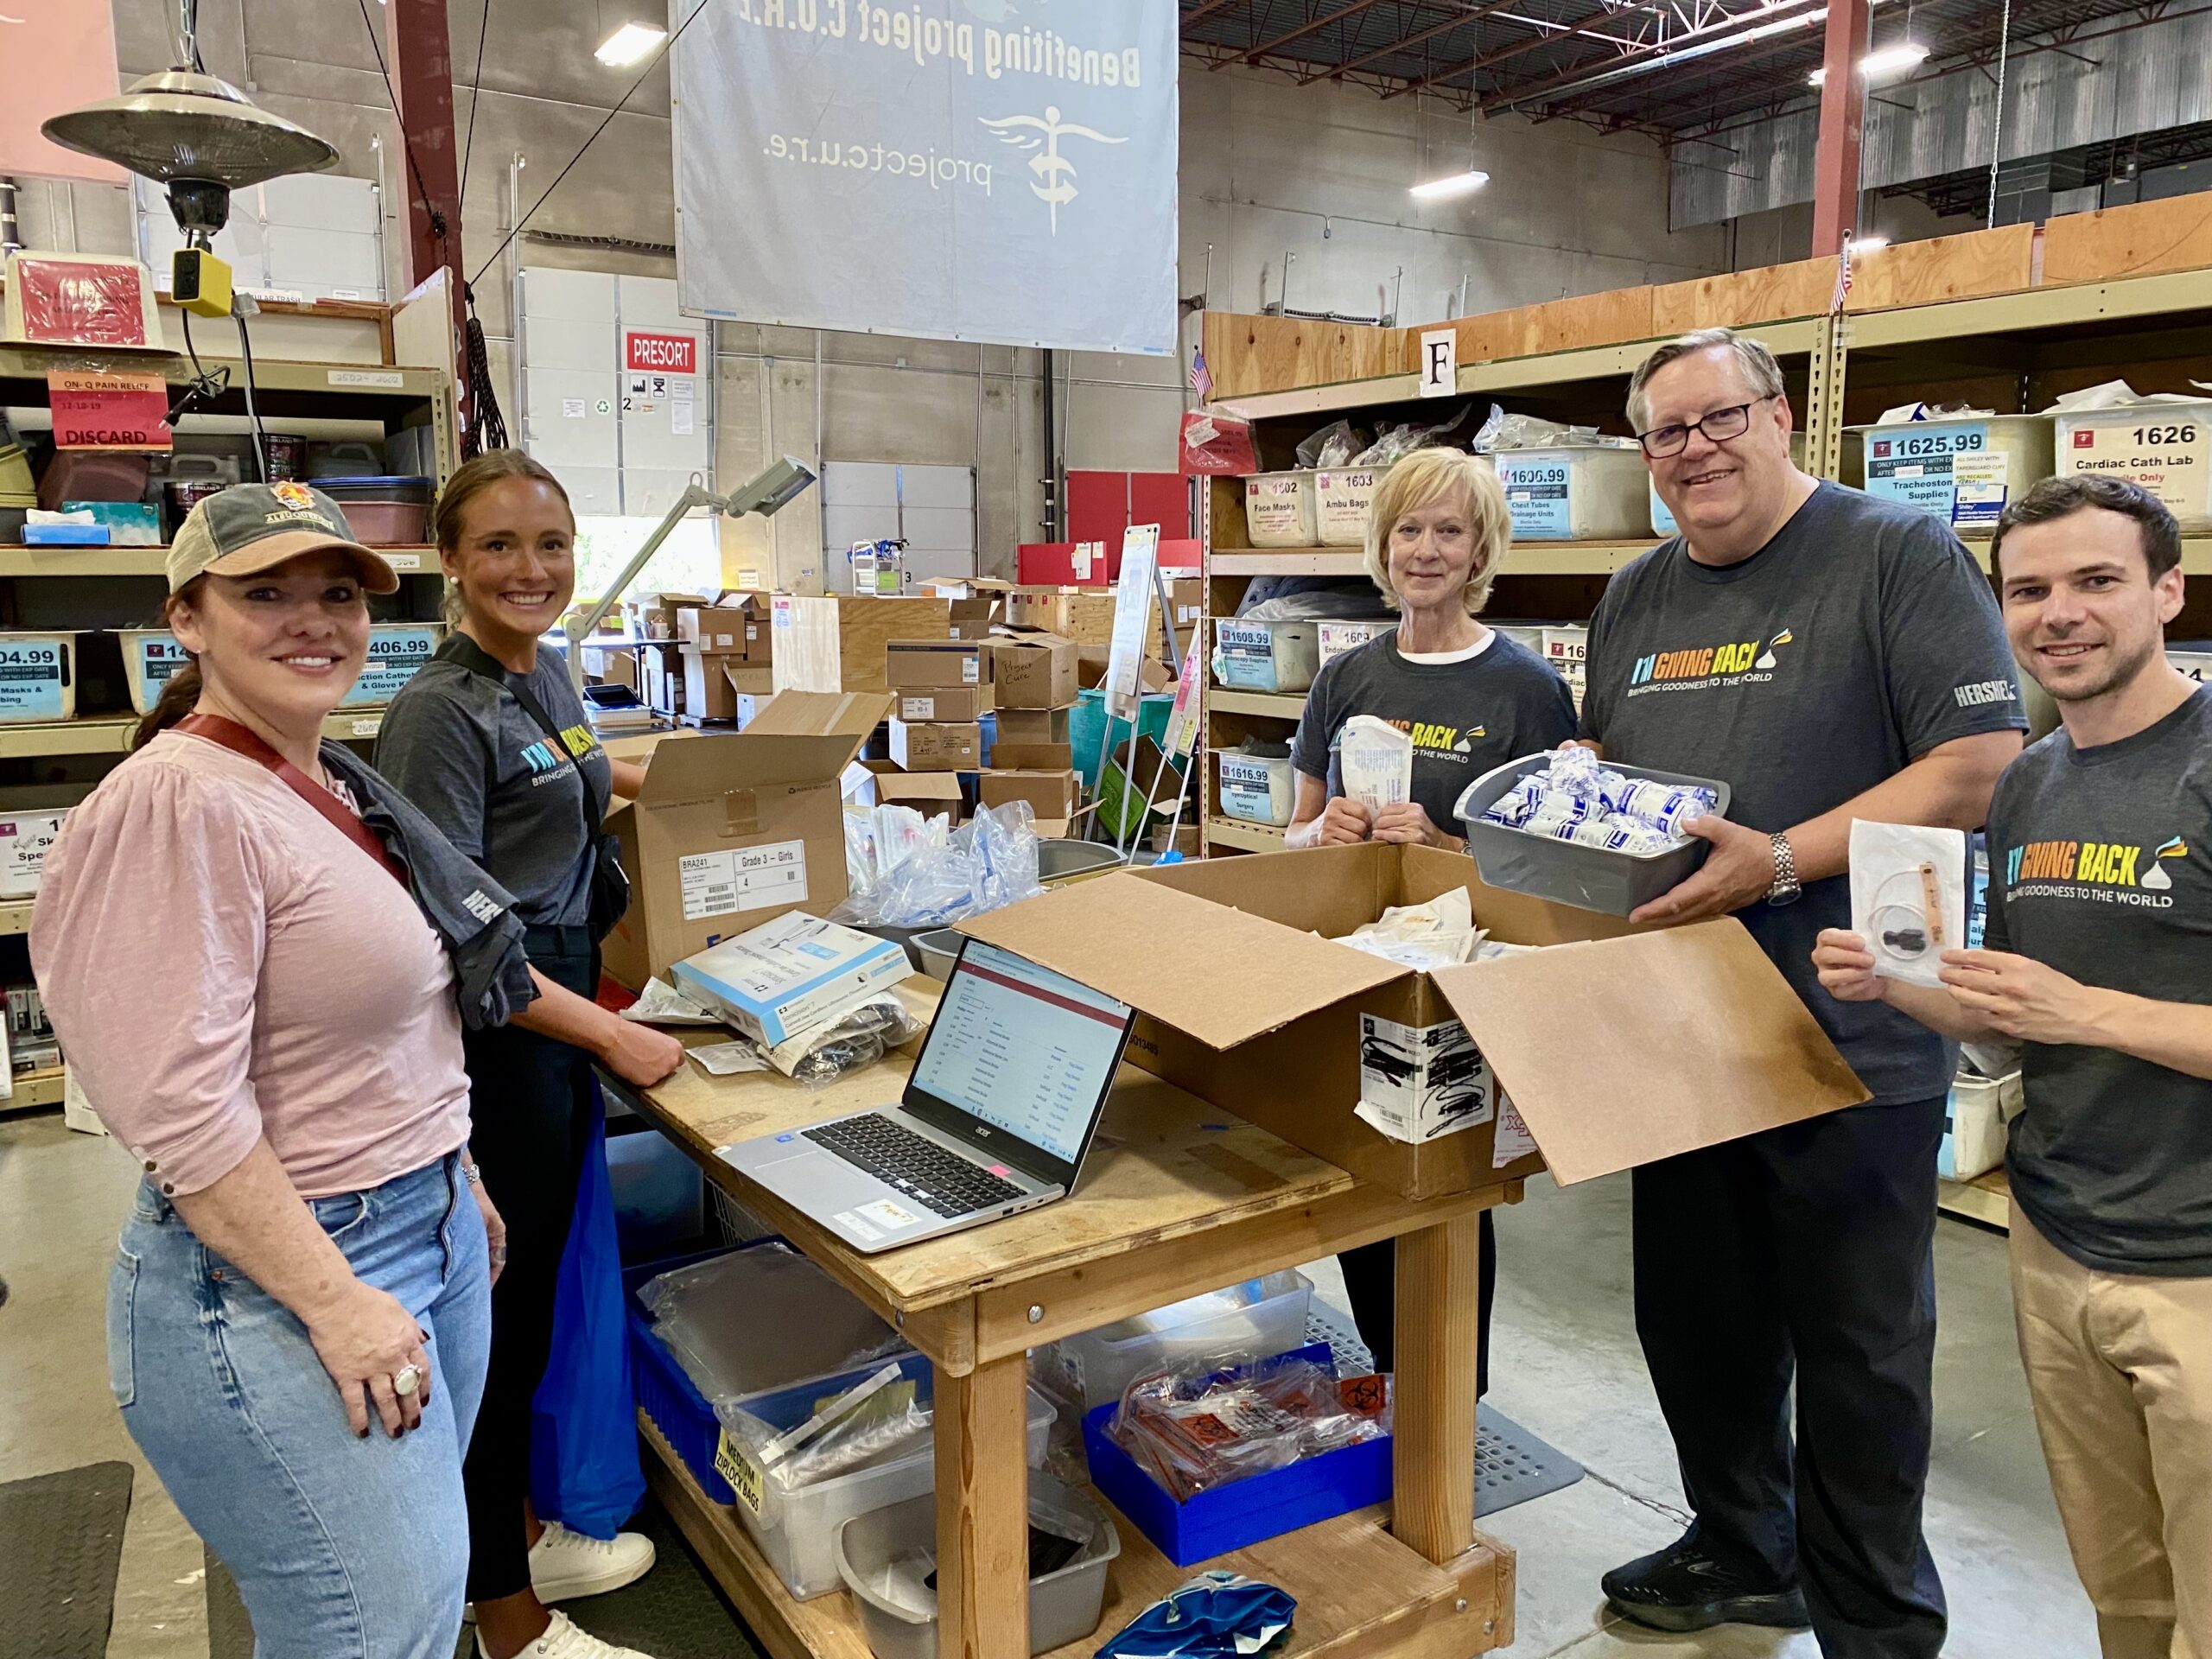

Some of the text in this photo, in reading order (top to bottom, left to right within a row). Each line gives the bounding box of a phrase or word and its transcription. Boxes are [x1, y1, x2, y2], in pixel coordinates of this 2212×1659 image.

[633, 338, 690, 367] PRESORT
[1427, 341, 1450, 385] F
[623, 397, 632, 410] 2
[66, 429, 147, 445] DISCARD
[2133, 425, 2196, 446] 1626
[1896, 433, 1982, 456] 1625.99
[1877, 460, 1892, 468] ONLY
[2076, 455, 2194, 470] Cardiac Cath Lab
[1345, 475, 1373, 487] 1603
[1892, 480, 1953, 491] Tracheostom
[2139, 474, 2165, 483] Only
[1908, 490, 1949, 500] Supplies
[1255, 503, 1295, 512] Face Masks
[1326, 499, 1369, 510] Ambu Bags
[906, 572, 912, 583] 3
[1231, 632, 1268, 645] 1608.99
[369, 640, 429, 654] 406.99
[1653, 647, 1713, 680] GIVING
[1662, 679, 1708, 692] GOODNESS
[1708, 677, 1720, 687] TO
[1722, 676, 1739, 686] THE
[0, 696, 22, 704] bing
[1411, 721, 1458, 751] BACK
[1419, 749, 1436, 758] THE
[1436, 752, 1469, 764] WORLD
[531, 765, 573, 787] BRINGING
[1230, 766, 1268, 781] 1616.99
[683, 858, 708, 869] BRA241
[741, 849, 793, 868] Grade 3 Girls
[2020, 841, 2077, 880] GIVING
[2076, 842, 2141, 887] BACK
[744, 877, 749, 887] 4
[2024, 885, 2075, 899] GOODNESS
[2076, 887, 2089, 899] TO
[2091, 890, 2114, 903] THE
[2116, 891, 2174, 908] WORLD
[975, 1125, 991, 1138] acer
[716, 1451, 760, 1512] ZIPLOCK BAGS
